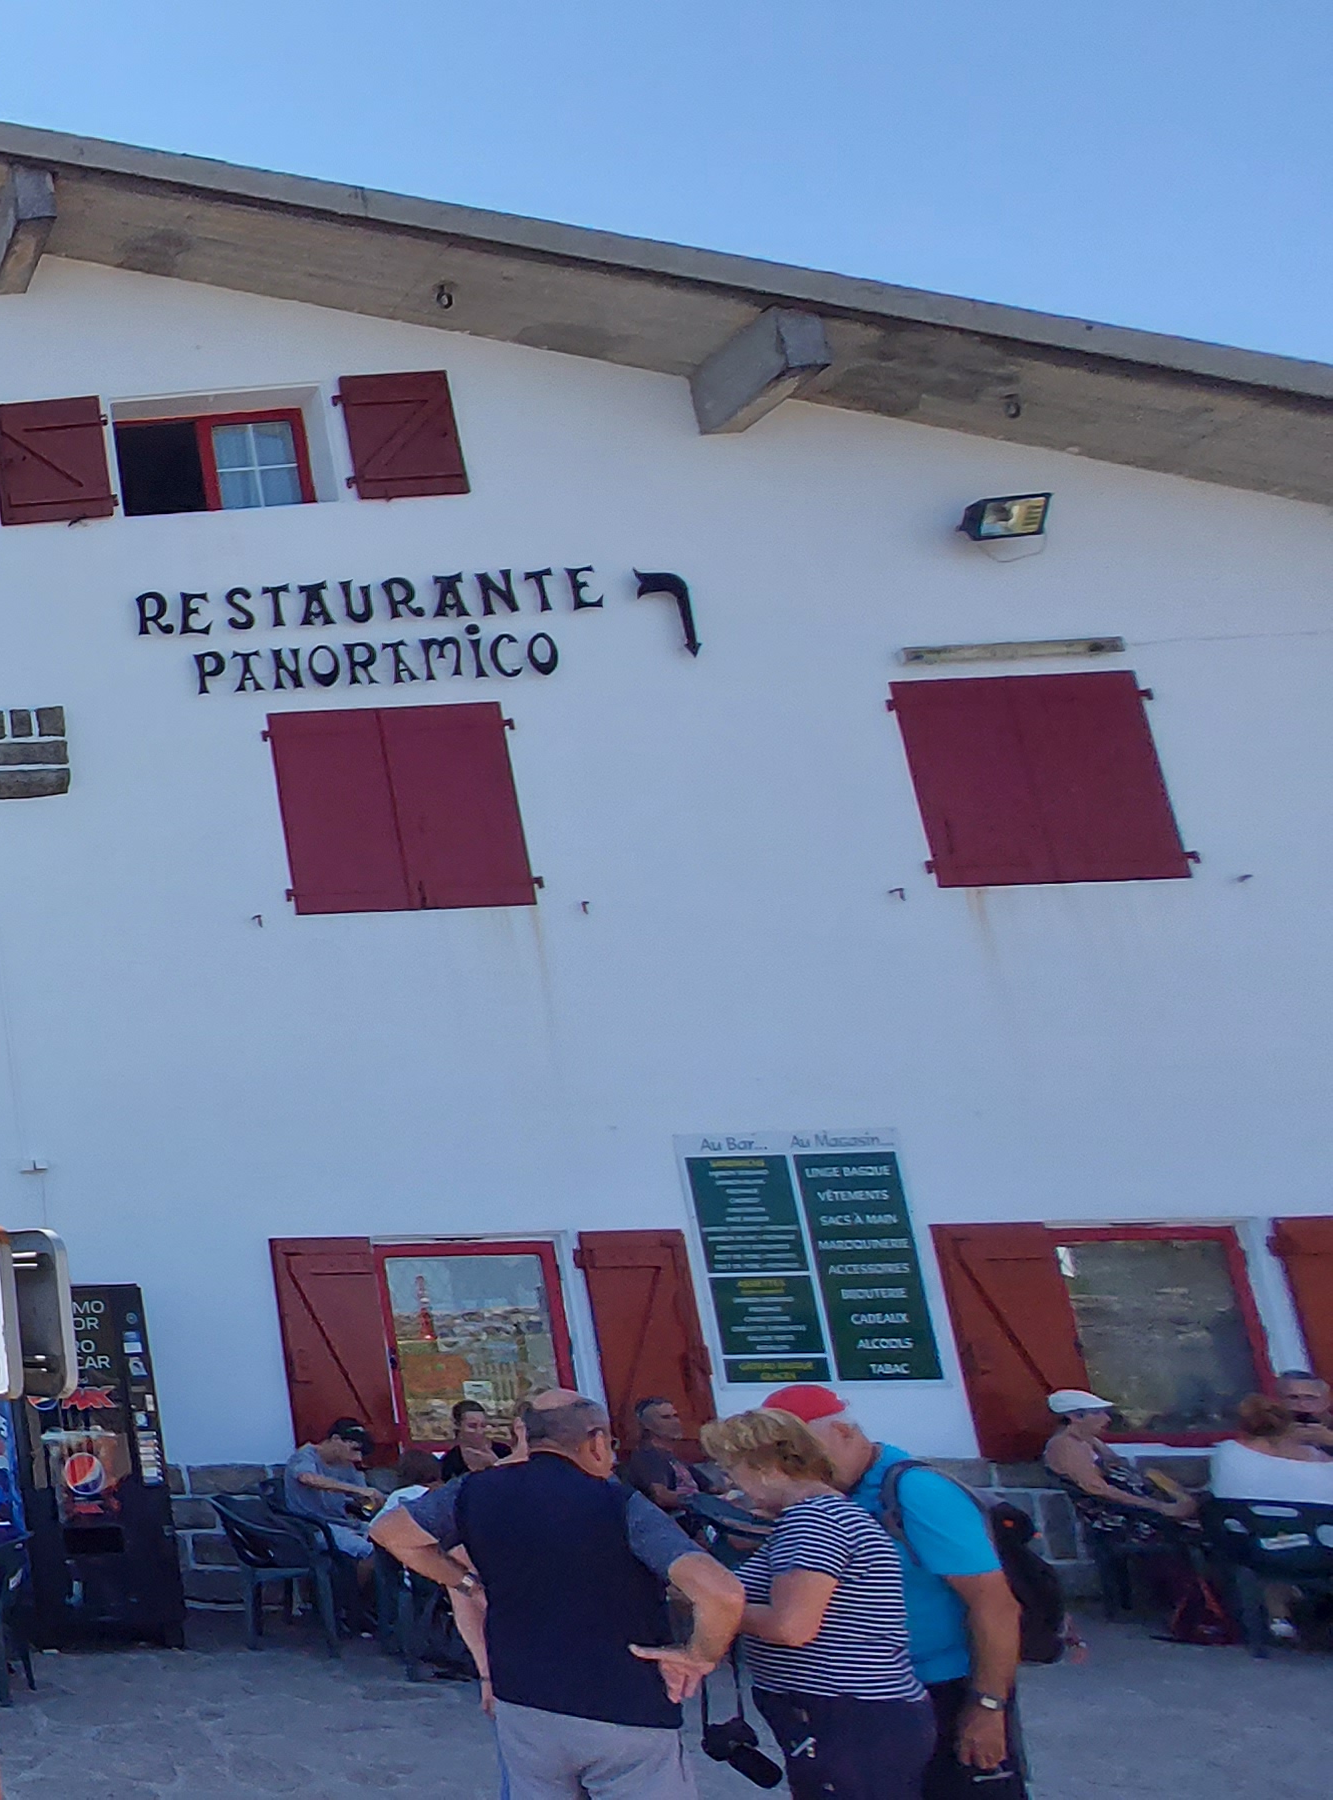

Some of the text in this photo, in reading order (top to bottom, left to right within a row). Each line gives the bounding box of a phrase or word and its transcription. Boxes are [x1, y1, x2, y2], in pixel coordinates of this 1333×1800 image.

[136, 565, 605, 636] RESTAURANTE
[820, 1214, 851, 1227] SACS
[869, 1363, 911, 1375] TABAC
